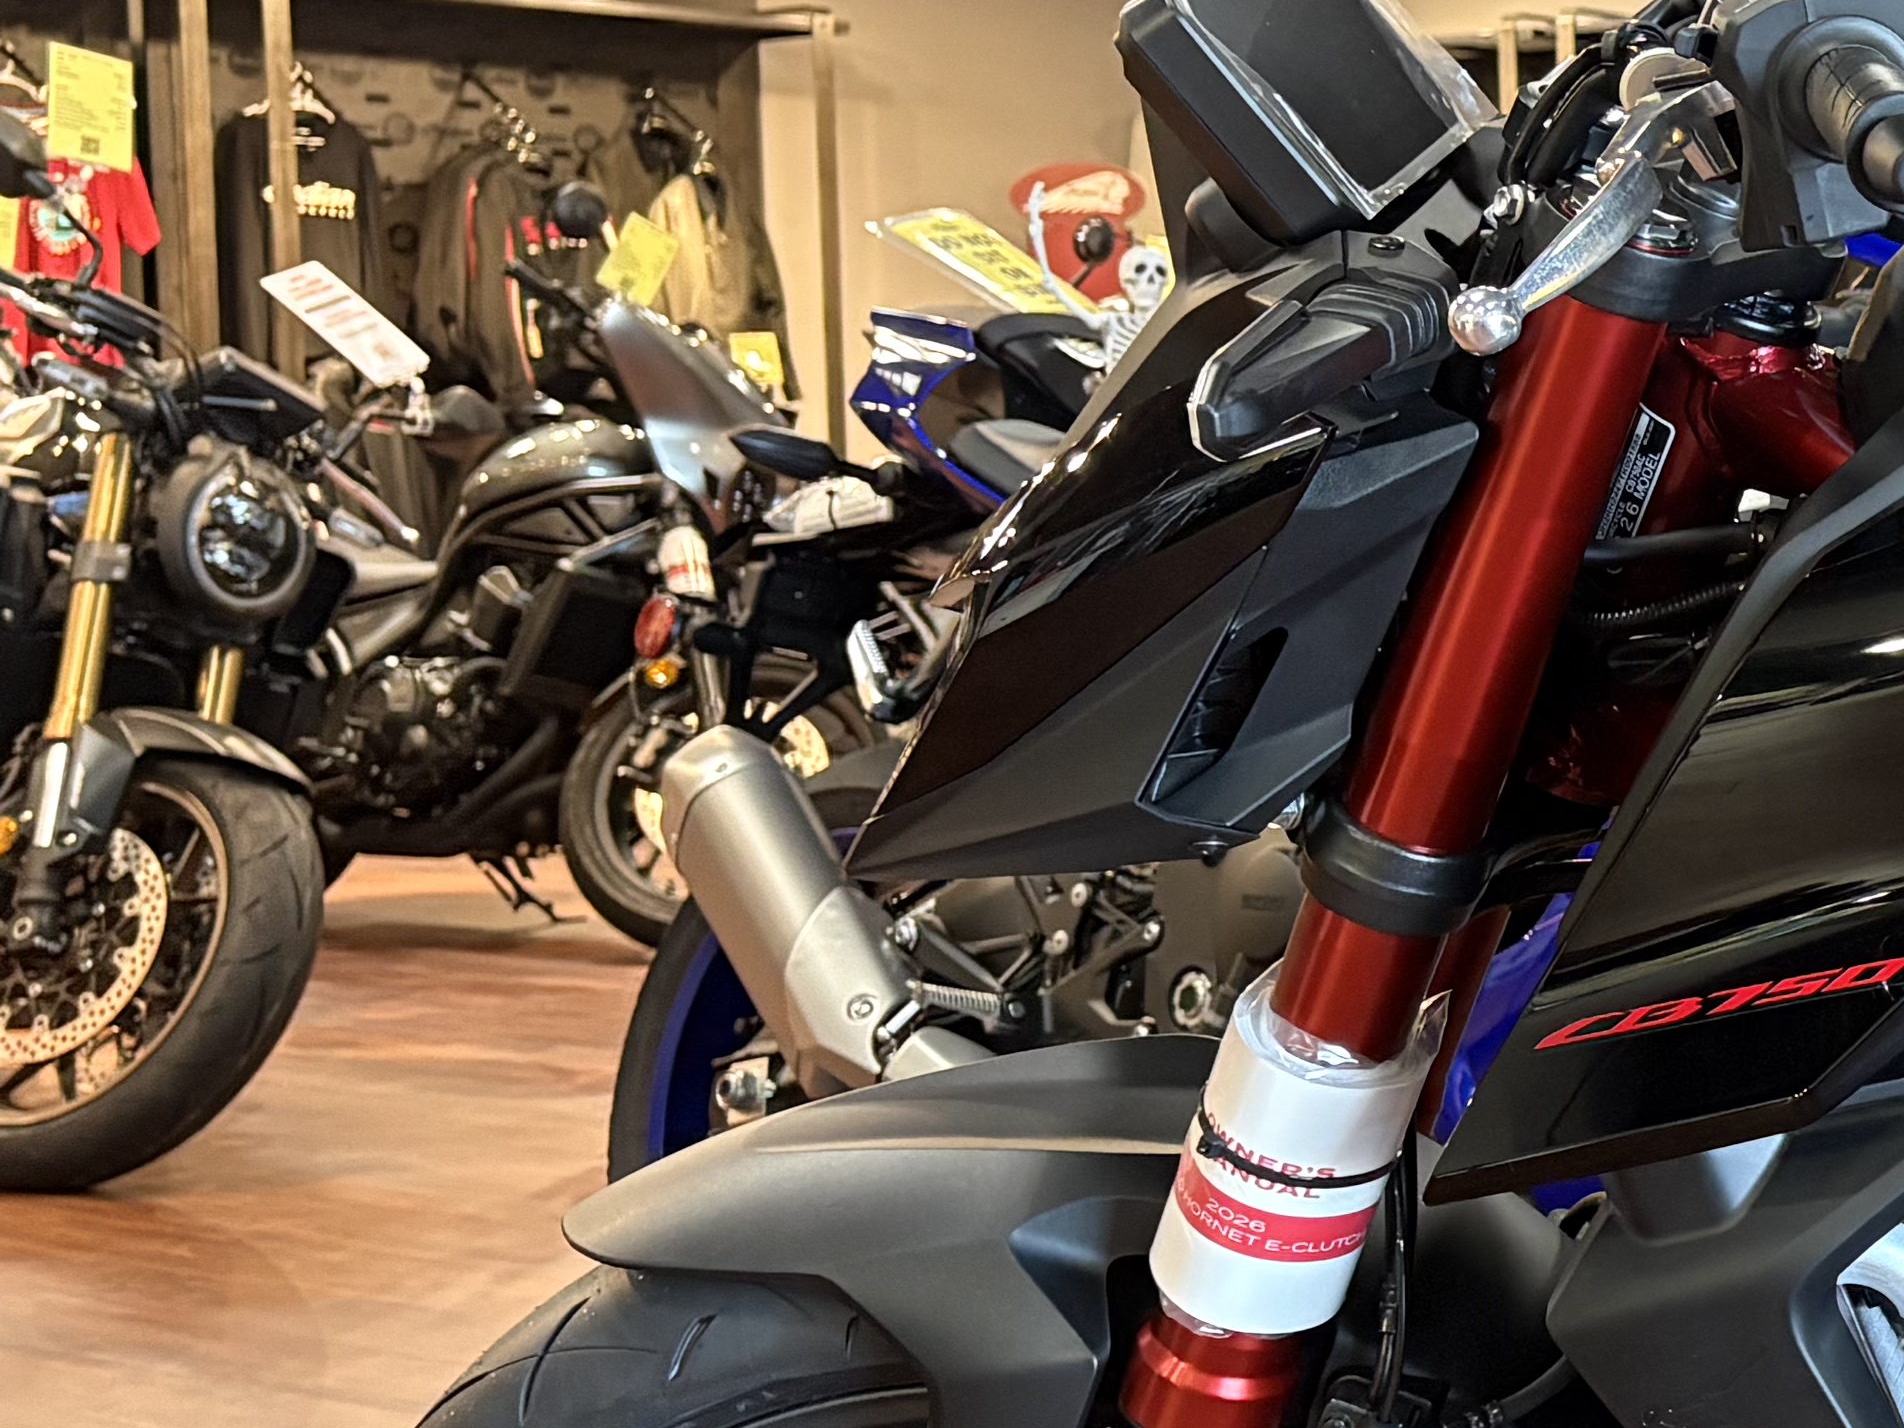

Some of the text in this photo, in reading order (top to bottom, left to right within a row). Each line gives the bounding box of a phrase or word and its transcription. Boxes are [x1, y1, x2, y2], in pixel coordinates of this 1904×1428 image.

[1633, 452, 1660, 501] MODEL
[1213, 1155, 1321, 1200] ANUAL
[1182, 1193, 1368, 1254] HORNET E-CLUTCH
[1205, 1197, 1267, 1233] 2026
